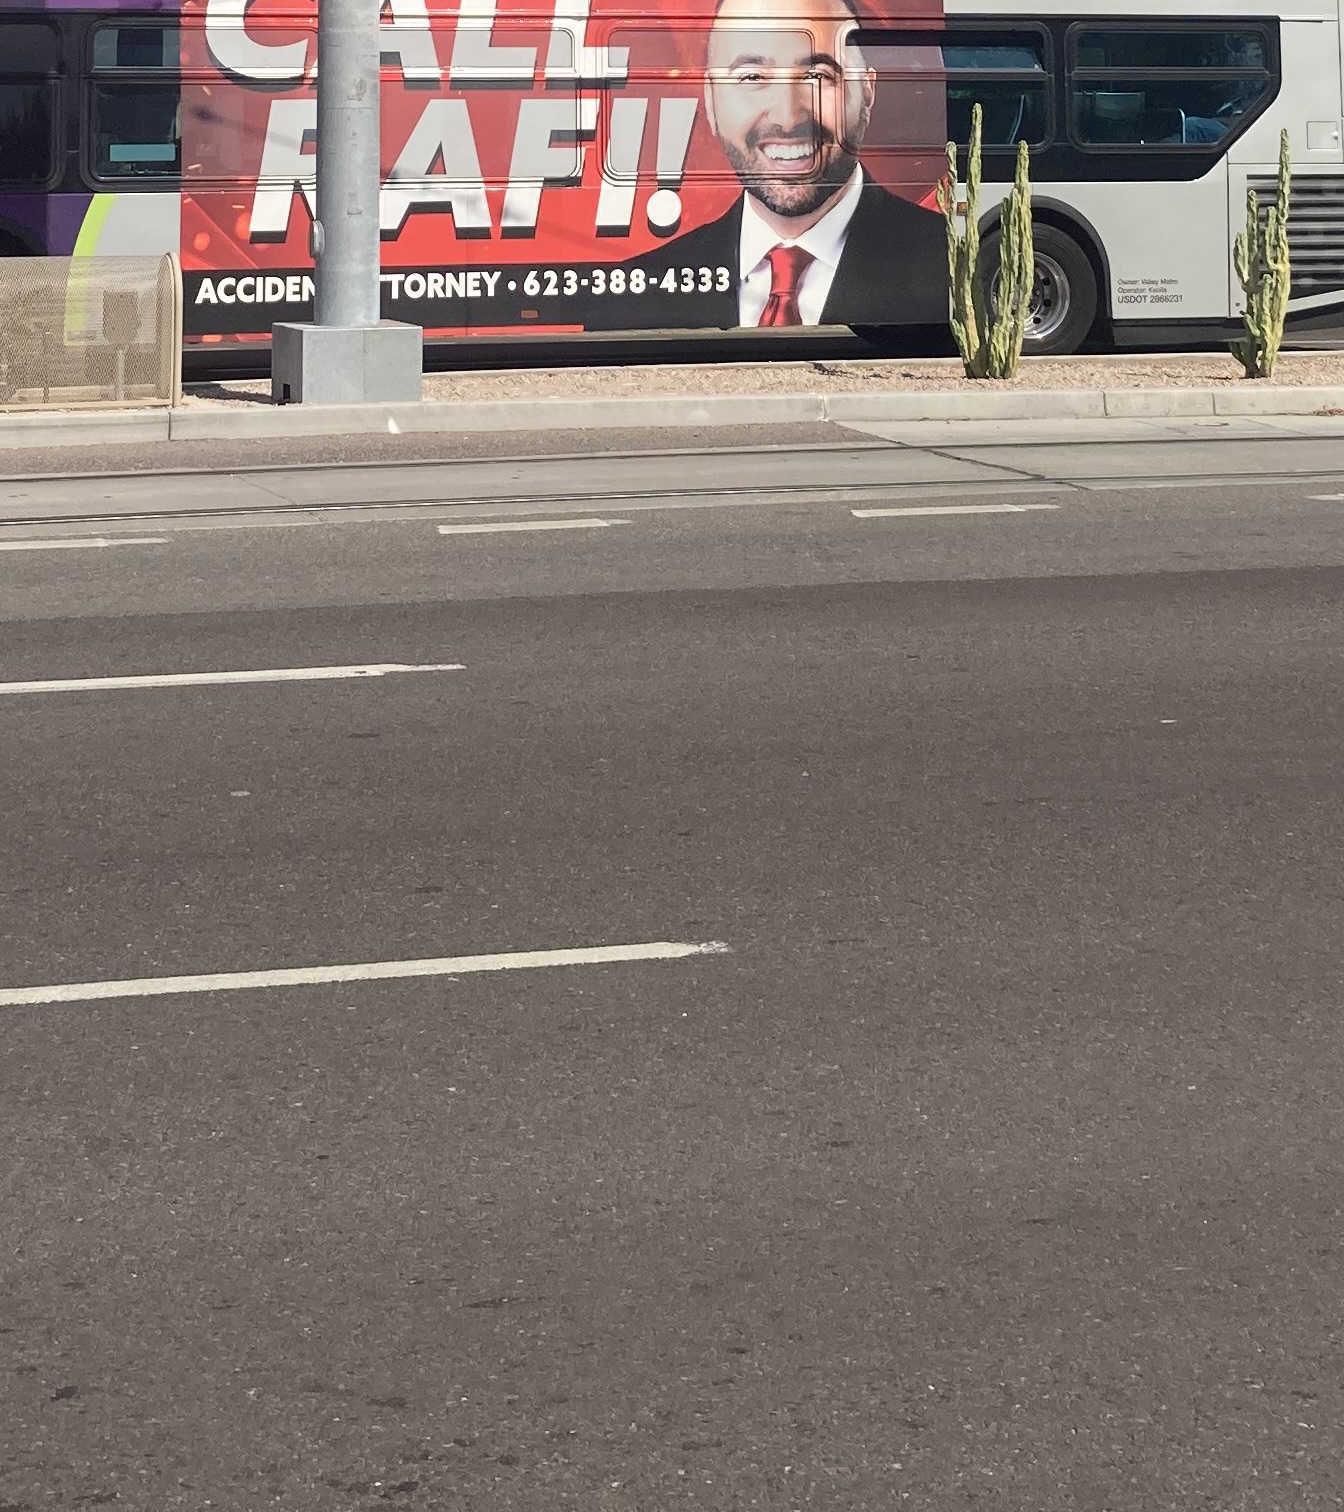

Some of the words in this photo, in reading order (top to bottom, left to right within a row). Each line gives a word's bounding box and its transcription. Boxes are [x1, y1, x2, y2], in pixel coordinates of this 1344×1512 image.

[249, 97, 699, 242] RAFI!
[195, 276, 316, 303] ACCIDEN
[379, 271, 502, 300] TORNEY
[523, 268, 731, 296] 623-388-4333
[1117, 295, 1148, 304] USDOT
